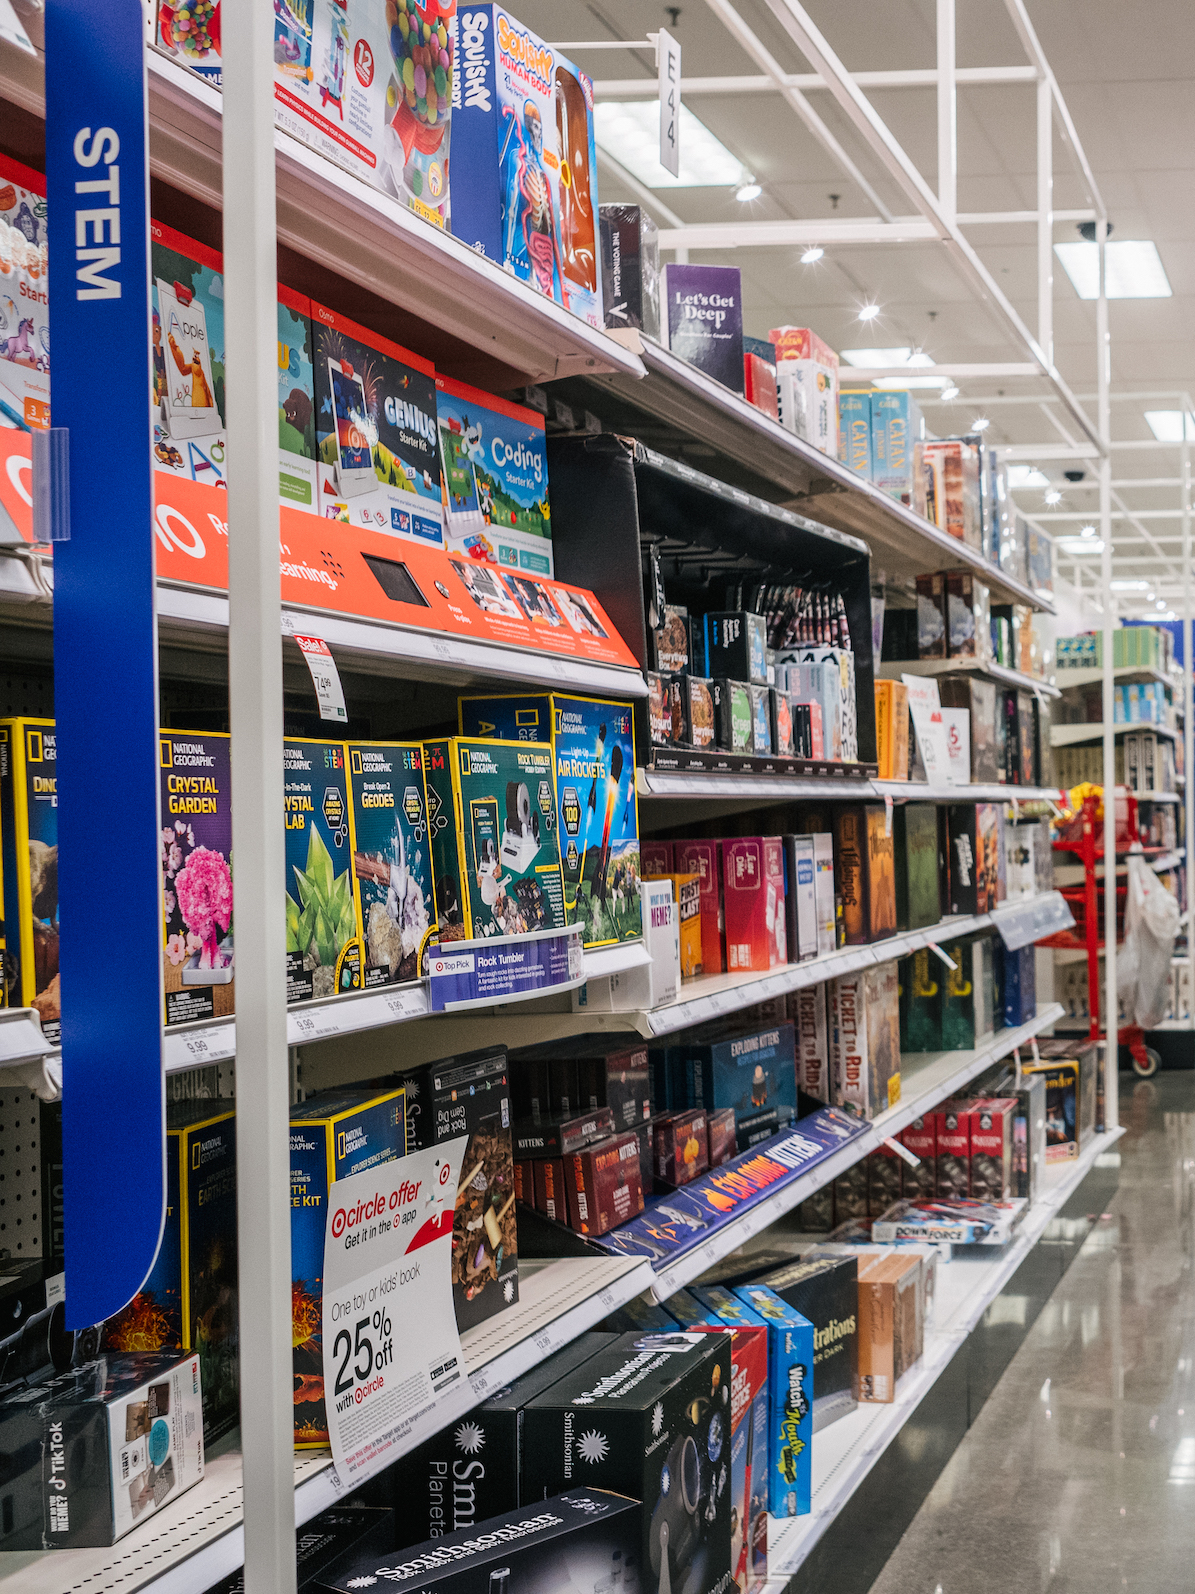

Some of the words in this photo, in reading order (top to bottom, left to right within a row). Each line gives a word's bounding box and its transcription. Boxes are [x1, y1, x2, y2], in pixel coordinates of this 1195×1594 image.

[357, 42, 373, 71] 12
[500, 53, 530, 84] HUMAN
[530, 76, 552, 98] BODY
[74, 127, 121, 301] STEM
[612, 231, 620, 245] THE
[613, 246, 621, 271] VOTING
[19, 281, 49, 306] Start
[614, 271, 622, 297] GAME
[676, 292, 709, 306] Let's
[709, 294, 735, 308] Get
[170, 307, 205, 342] Apple
[318, 308, 335, 324] Osmo
[685, 306, 726, 329] Deep
[31, 405, 37, 416] 3
[384, 395, 437, 447] GENIUS
[399, 431, 418, 448] Starter
[418, 438, 428, 452] Kit
[852, 420, 868, 471] CATAN
[890, 418, 905, 468] CATAN
[491, 437, 542, 483] Coding
[506, 471, 525, 487] Starter
[525, 479, 535, 490] Kit
[279, 560, 339, 591] earning.
[297, 637, 323, 653] Sale!
[658, 650, 688, 665] Everything
[562, 712, 583, 724] NATIONAL
[731, 715, 751, 731] Green
[562, 723, 587, 735] GEOGRAPHIC
[173, 743, 206, 755] NATIONAL
[362, 753, 385, 762] NATIONAL
[470, 752, 491, 763] NATIONAL
[173, 755, 213, 767] GEOGRAPHIC
[324, 757, 343, 769] STEM
[363, 763, 392, 772] GEOGRAPHIC
[404, 758, 421, 770] STEM
[471, 762, 498, 774] GEOGRAPHIC
[517, 753, 531, 765] ROCK
[531, 754, 550, 766] TUMBLER
[558, 758, 571, 777] AIR
[571, 759, 605, 779] ROCKETS
[168, 774, 219, 794] CRYSTAL
[169, 795, 217, 814] GARDEN
[361, 793, 395, 808] GEODES
[285, 814, 305, 829] LAB
[565, 807, 578, 822] 100
[651, 905, 671, 928] MEME?
[444, 962, 455, 970] Top
[456, 960, 470, 969] Pick
[478, 956, 497, 968] Rock
[498, 952, 525, 964] Tumbler
[388, 1001, 404, 1011] 9.99
[841, 983, 858, 1039] TICKET
[297, 1019, 315, 1030] 9.99
[187, 1040, 208, 1053] 9.99
[731, 1037, 759, 1057] EXPLODING
[759, 1031, 780, 1049] KITTENS
[805, 1058, 821, 1094] RIDE
[846, 1055, 862, 1091] RIDE
[345, 1126, 363, 1142] NATIONAL
[437, 1124, 450, 1138] and
[451, 1118, 466, 1132] Rock
[518, 1138, 545, 1148] KITTENS
[595, 1150, 619, 1172] EXPLODING
[619, 1142, 637, 1160] KITTENS
[713, 1155, 789, 1200] EXPLODING
[764, 1133, 823, 1169] KITTENS
[303, 1195, 321, 1206] KIT
[347, 1192, 386, 1228] circle
[389, 1180, 422, 1210] offer
[345, 1234, 360, 1250] Get
[361, 1230, 368, 1242] it
[369, 1225, 377, 1238] in
[379, 1219, 392, 1234] the
[402, 1208, 417, 1225] app
[332, 1302, 352, 1321] One
[354, 1295, 367, 1312] toy
[368, 1286, 378, 1301] or
[379, 1272, 398, 1295] kids'
[399, 1262, 421, 1286] book
[813, 1315, 856, 1350] trations
[536, 1338, 551, 1350] 12.99
[375, 1338, 394, 1371] off
[581, 1351, 656, 1399] Smithsonian
[336, 1394, 354, 1413] with
[362, 1375, 385, 1398] circle
[471, 1378, 488, 1394] 24.99
[789, 1366, 804, 1409] Watch
[50, 1421, 64, 1473] TikTok
[563, 1411, 575, 1479] Smithsonian
[56, 1495, 69, 1532] MEME?
[375, 1512, 557, 1579] Smithsonian
